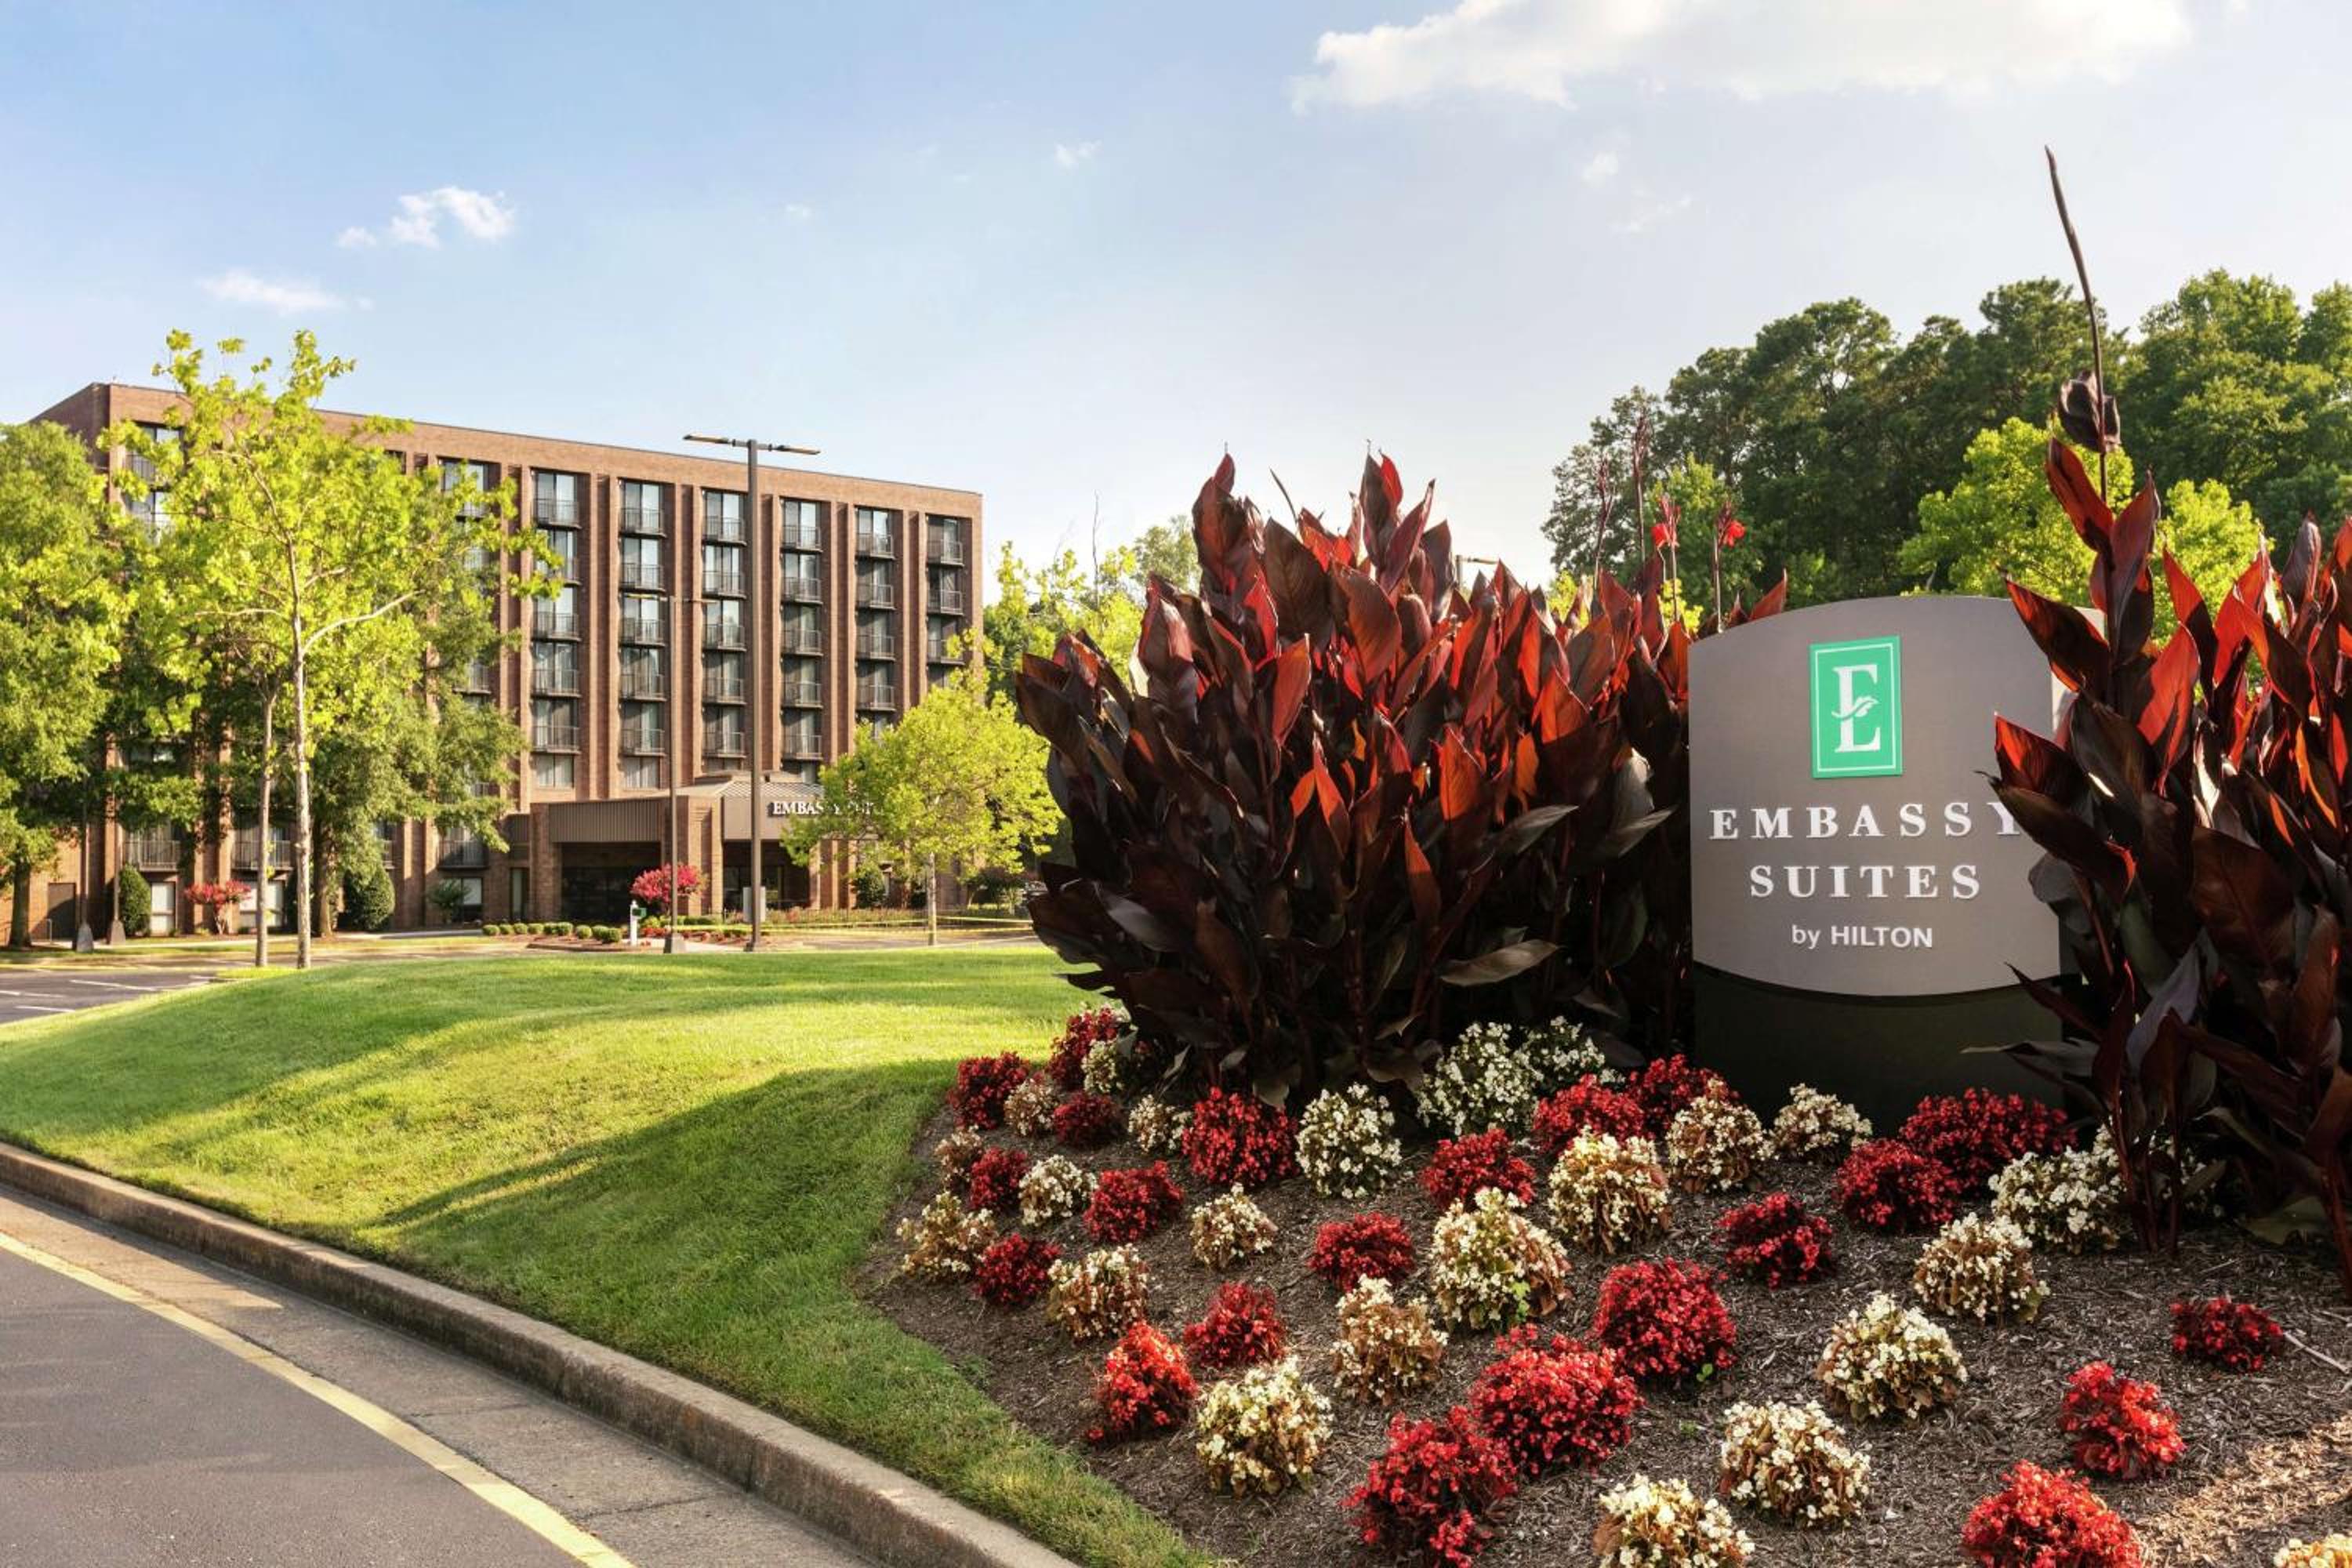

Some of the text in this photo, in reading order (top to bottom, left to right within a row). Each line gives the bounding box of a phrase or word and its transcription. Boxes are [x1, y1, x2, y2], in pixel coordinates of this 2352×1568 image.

[1832, 664, 1881, 753] E
[772, 800, 843, 815] EMBASY
[1750, 865, 1980, 899] SUITES
[1792, 924, 1933, 949] by HILTON
